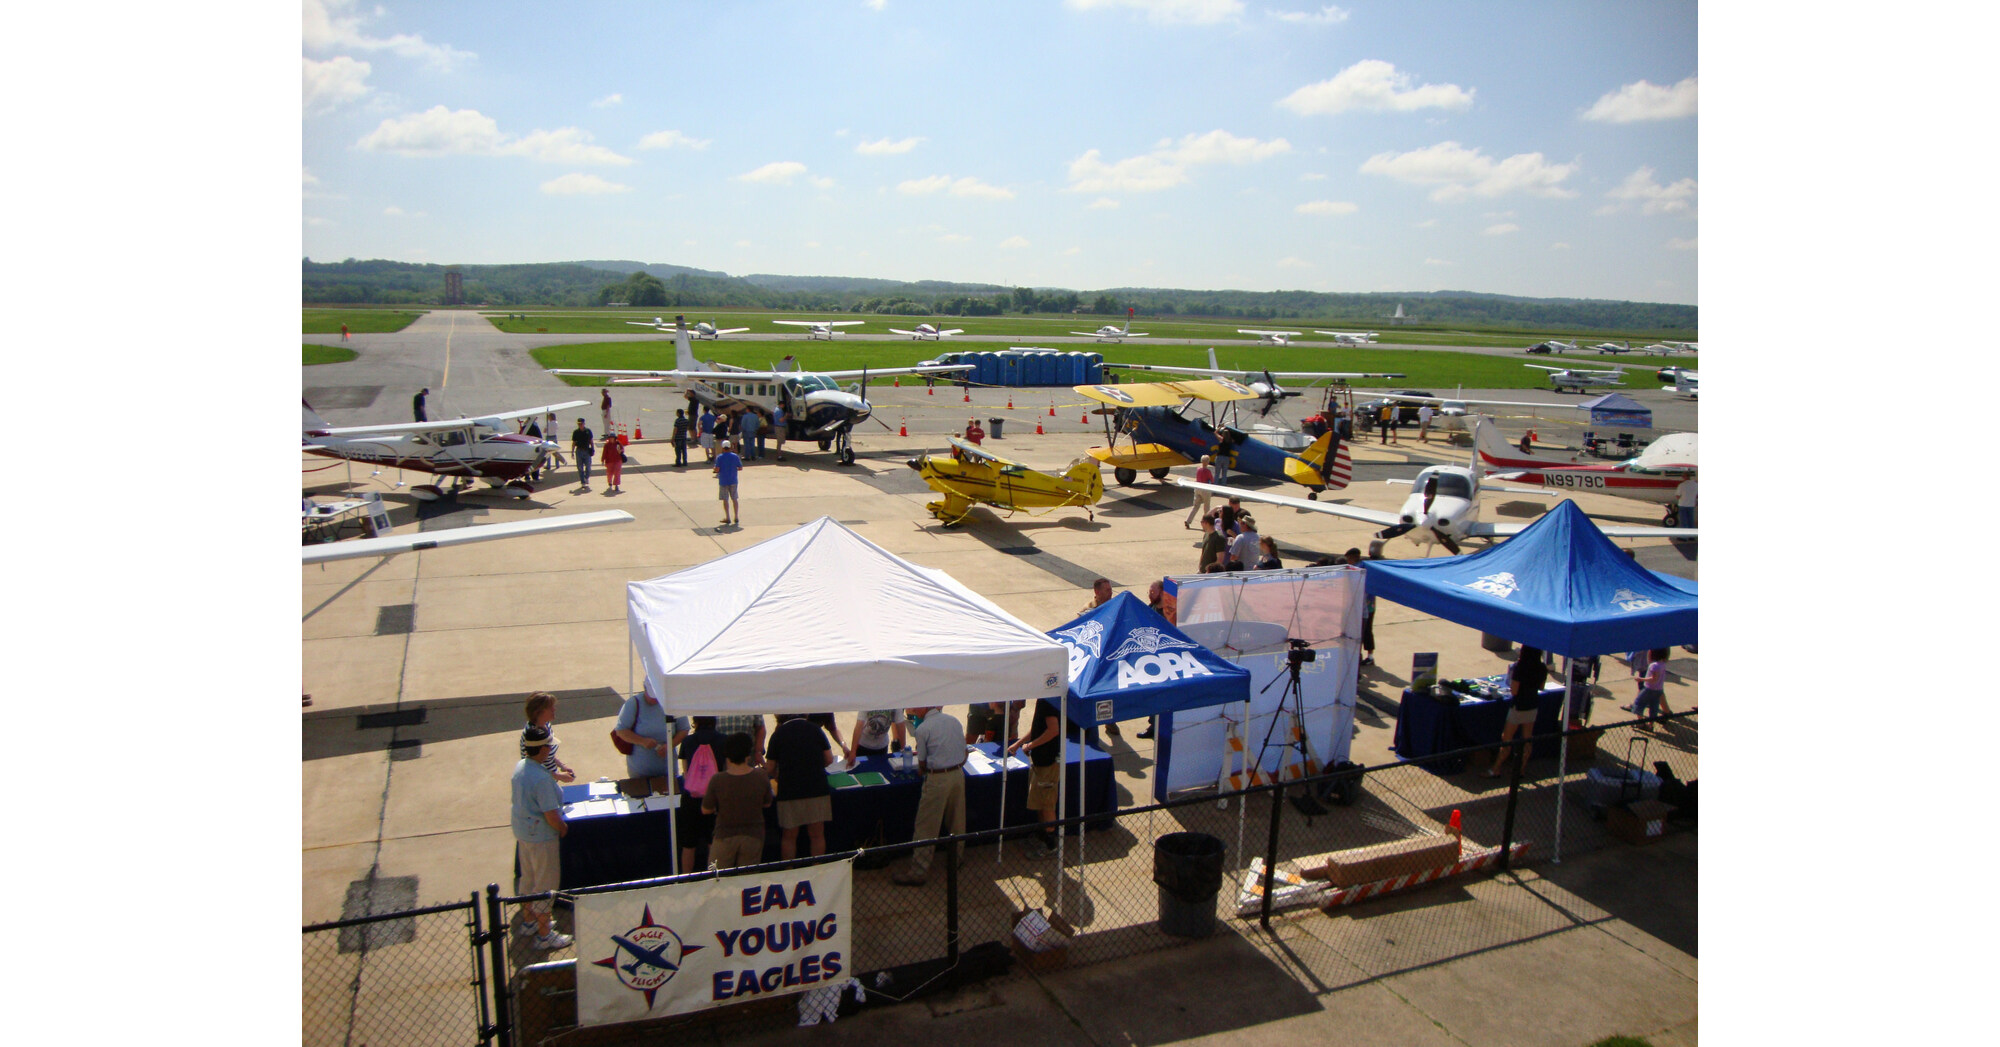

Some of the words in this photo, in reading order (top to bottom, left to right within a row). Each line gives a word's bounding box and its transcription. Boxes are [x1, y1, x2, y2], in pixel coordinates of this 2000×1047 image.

[1546, 473, 1604, 488] N9979C
[1464, 579, 1514, 598] AOPA
[1118, 650, 1214, 689] AOPA
[742, 880, 816, 917] EAA
[632, 930, 664, 943] EAGLE
[715, 912, 837, 958] YOUNG
[631, 970, 666, 986] FLIGHT
[712, 951, 842, 1001] EAGLES
